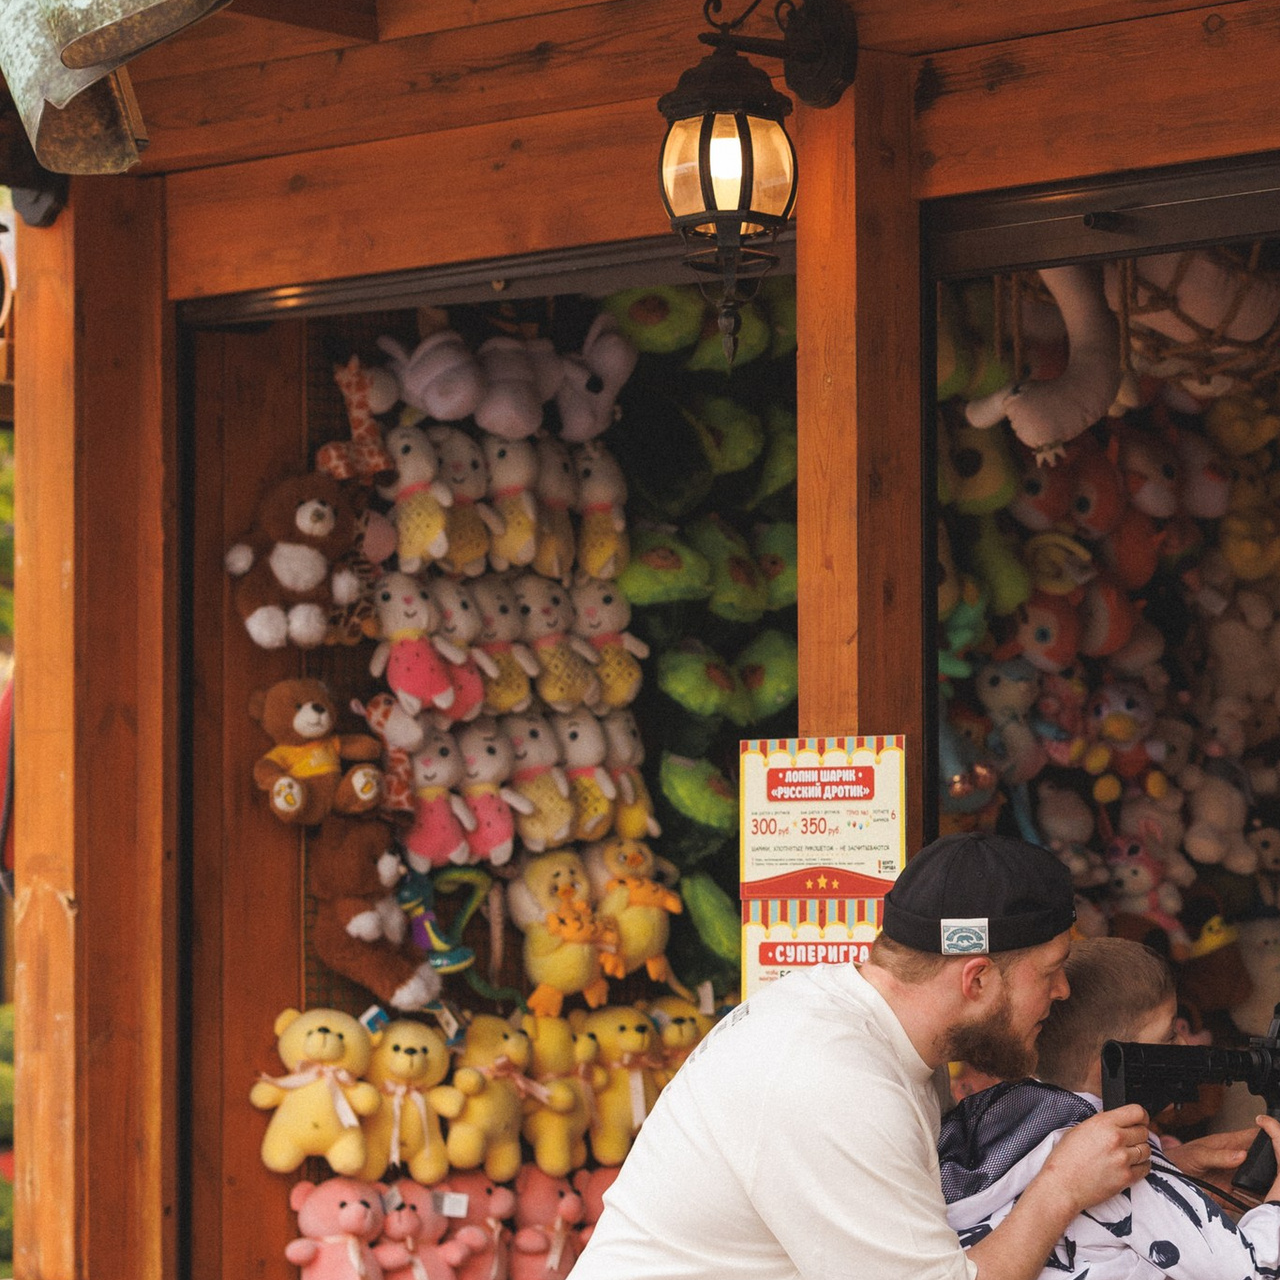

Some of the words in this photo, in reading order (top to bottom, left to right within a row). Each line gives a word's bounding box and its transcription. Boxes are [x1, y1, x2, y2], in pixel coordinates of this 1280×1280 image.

[785, 770, 818, 783] ЛОПНИ
[820, 769, 856, 782] ШАРИК
[771, 782, 822, 799] «РУССКИЙ
[823, 785, 870, 800] ДРОТИК»
[891, 809, 897, 820] 6
[751, 818, 777, 835] 300
[801, 817, 827, 834] 350
[775, 945, 869, 963] СУПЕРИГРА
